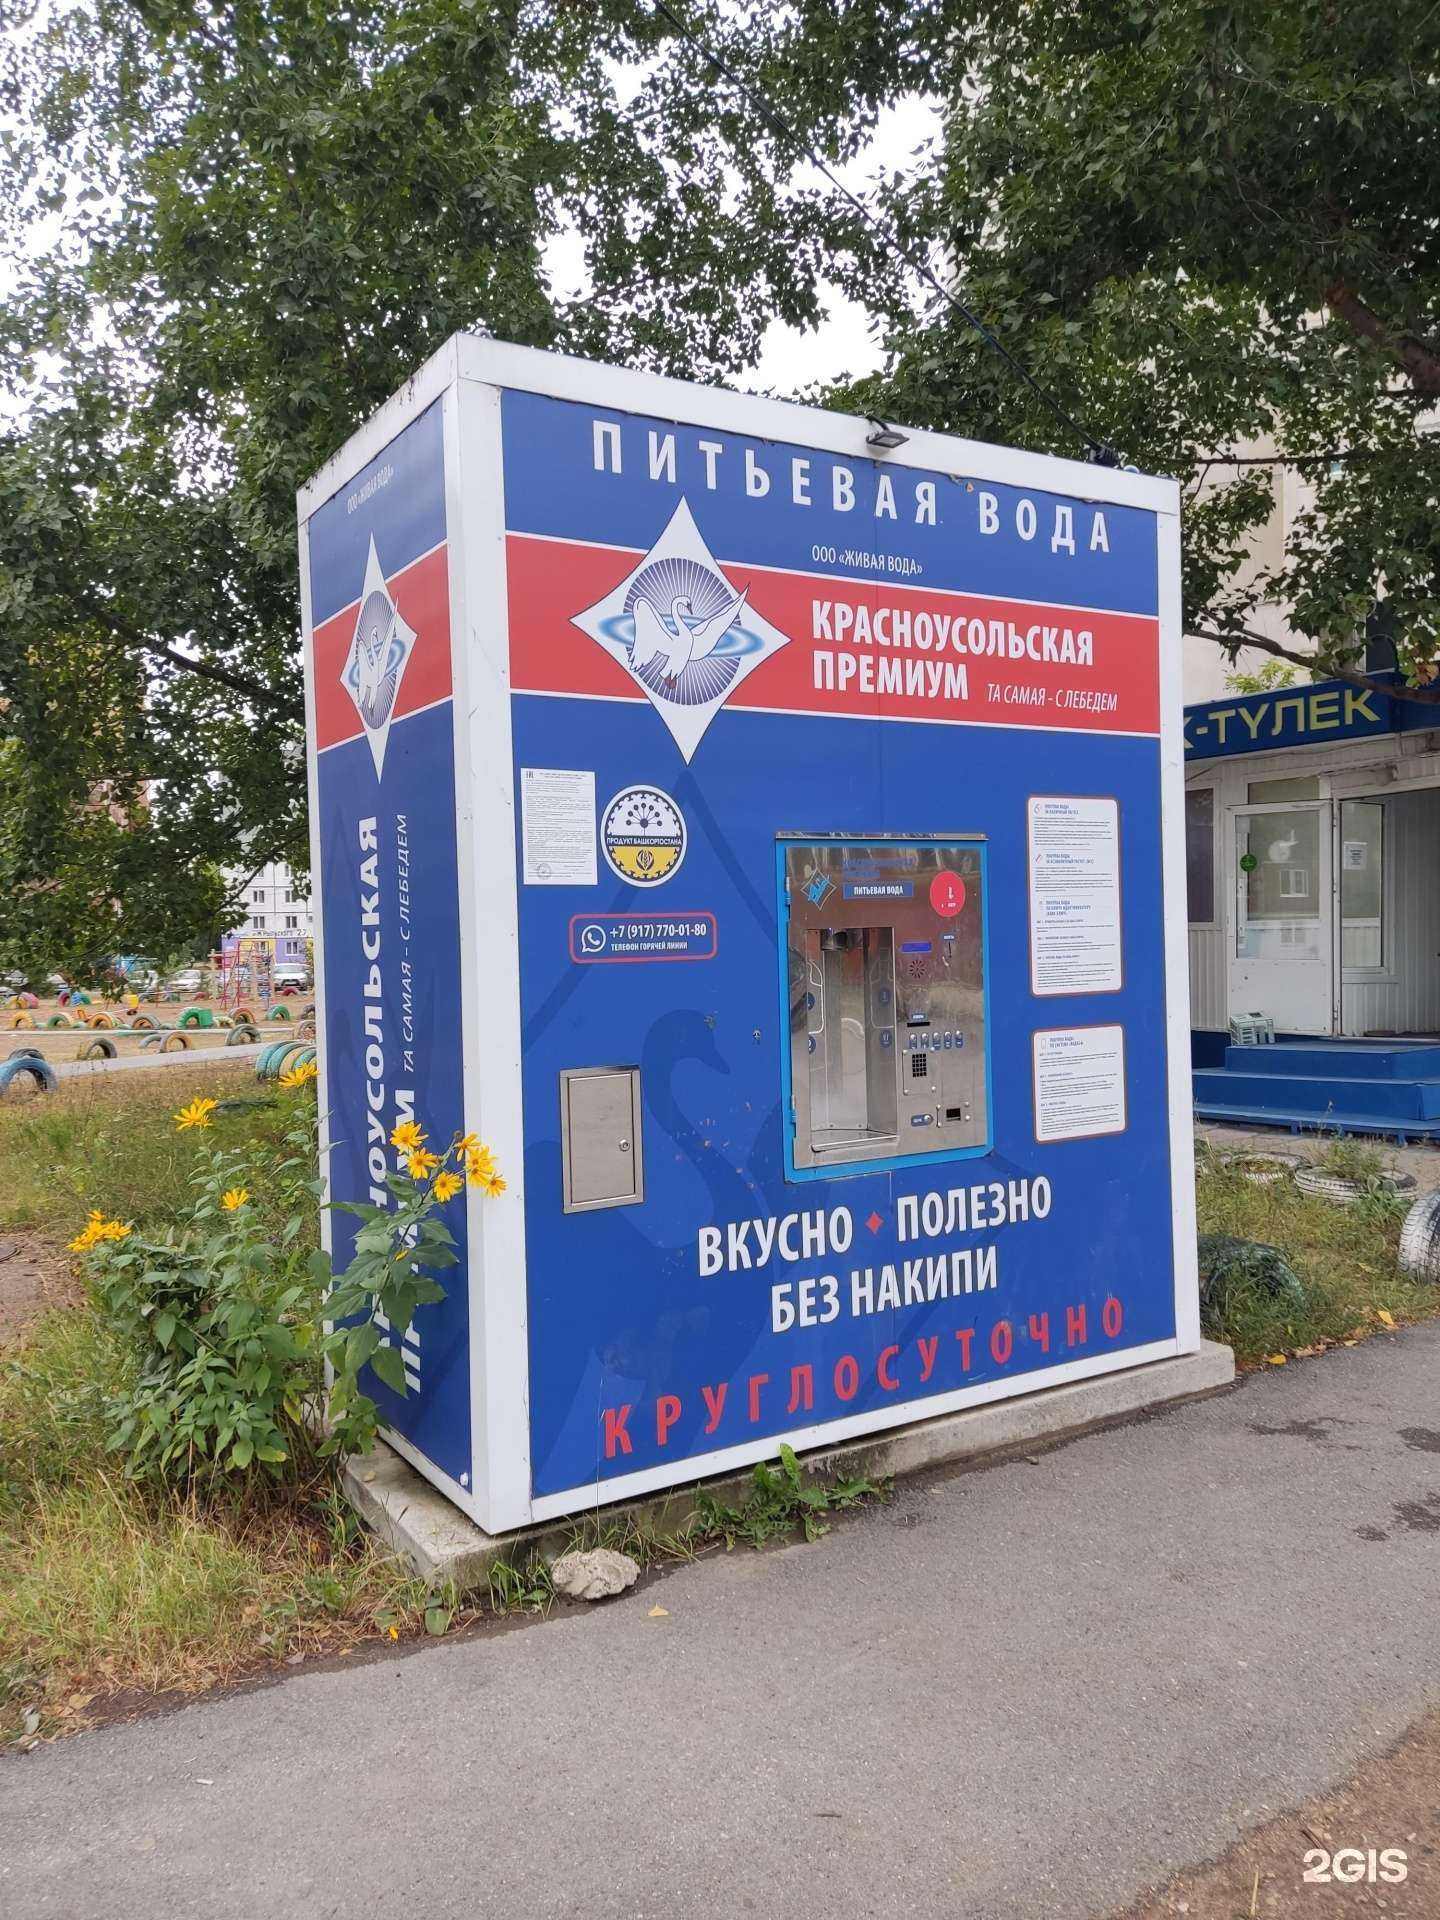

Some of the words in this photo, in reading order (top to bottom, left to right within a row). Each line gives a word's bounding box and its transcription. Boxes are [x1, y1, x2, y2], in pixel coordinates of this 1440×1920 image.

[592, 420, 937, 526] ПИТЬЕВАЯ
[979, 491, 1110, 556] ВОДА
[812, 545, 836, 564] ООО
[839, 550, 886, 572] «ЖИВАЯ
[888, 556, 923, 576] ВОДА»
[812, 600, 1094, 666] КРАСНОУСОЛЬСКАЯ
[813, 650, 969, 700] ПРЕМИУМ
[987, 684, 1001, 702] ТА
[1004, 685, 1046, 706] САМАЯ
[1056, 689, 1064, 708] С
[1064, 690, 1118, 713] ЛЕБЕДЕМ
[606, 837, 632, 845] ПРОДУКТ
[633, 837, 682, 846] БАШКОРТОСТАНА
[397, 813, 411, 924] ЛЕБЕДЕМ
[853, 886, 886, 896] ПИТЬЕВАЯ
[886, 886, 904, 895] ВОДА
[400, 926, 411, 941] С
[609, 924, 625, 939] +7
[627, 924, 655, 940] (917)
[656, 923, 707, 938] 770-01-80
[611, 943, 639, 952] ТЕЛЕФОН
[639, 941, 666, 951] ГОРЯЧЕЙ
[401, 962, 415, 1043] САМАЯ
[401, 1050, 415, 1073] ТА
[698, 1206, 853, 1278] ВКУСНО
[897, 1176, 1053, 1243] ПОЛЕЗНО
[771, 1274, 840, 1333] БЕЗ
[851, 1246, 998, 1318] НАКИПИ
[604, 1297, 1123, 1459] КРУГЛОСУТОЧНО
